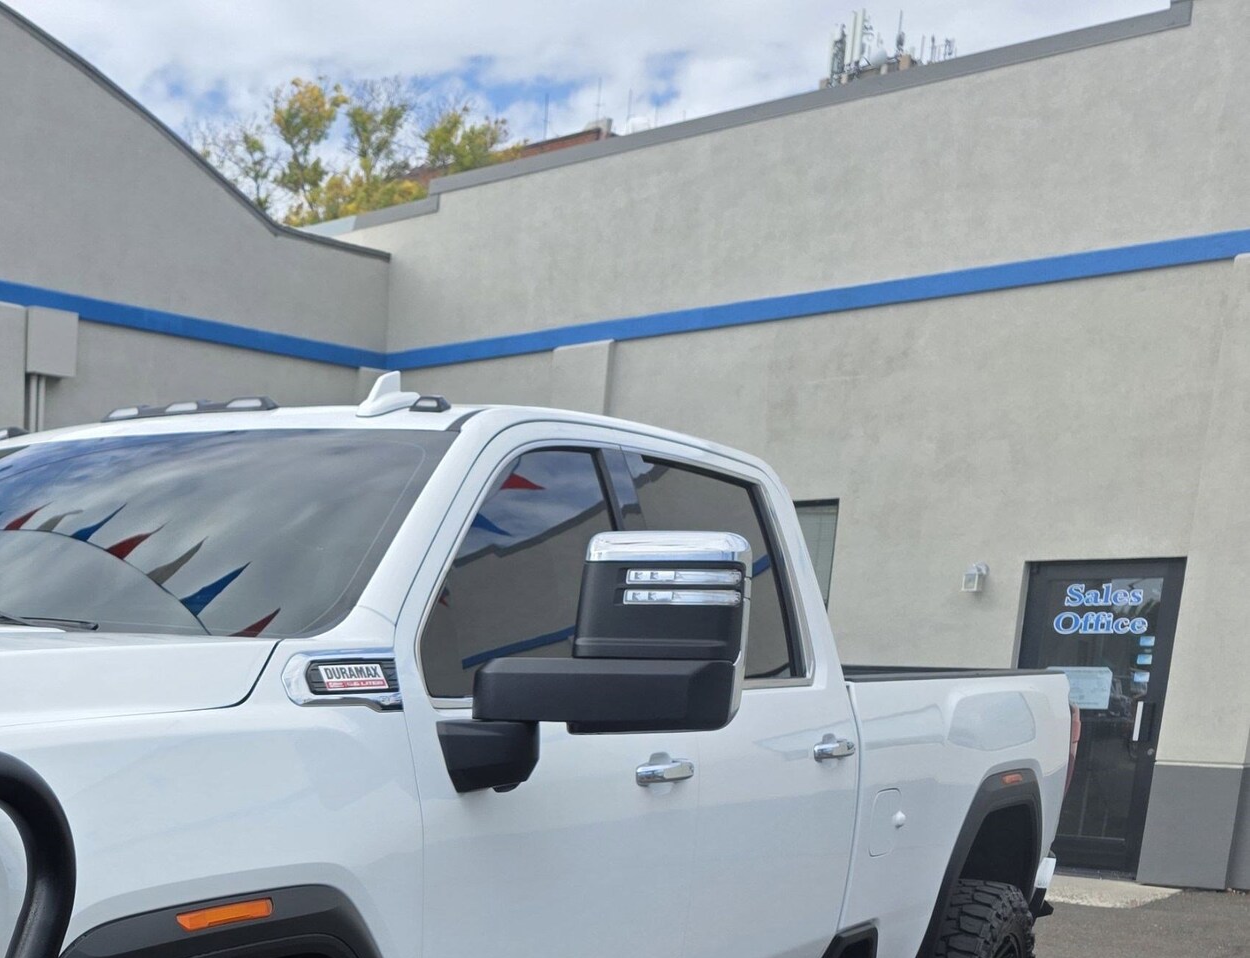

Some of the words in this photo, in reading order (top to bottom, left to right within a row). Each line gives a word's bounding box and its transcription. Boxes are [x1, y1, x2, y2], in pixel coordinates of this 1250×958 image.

[1064, 583, 1144, 607] Sales
[1053, 611, 1149, 635] Office
[324, 666, 381, 679] DURAMAX
